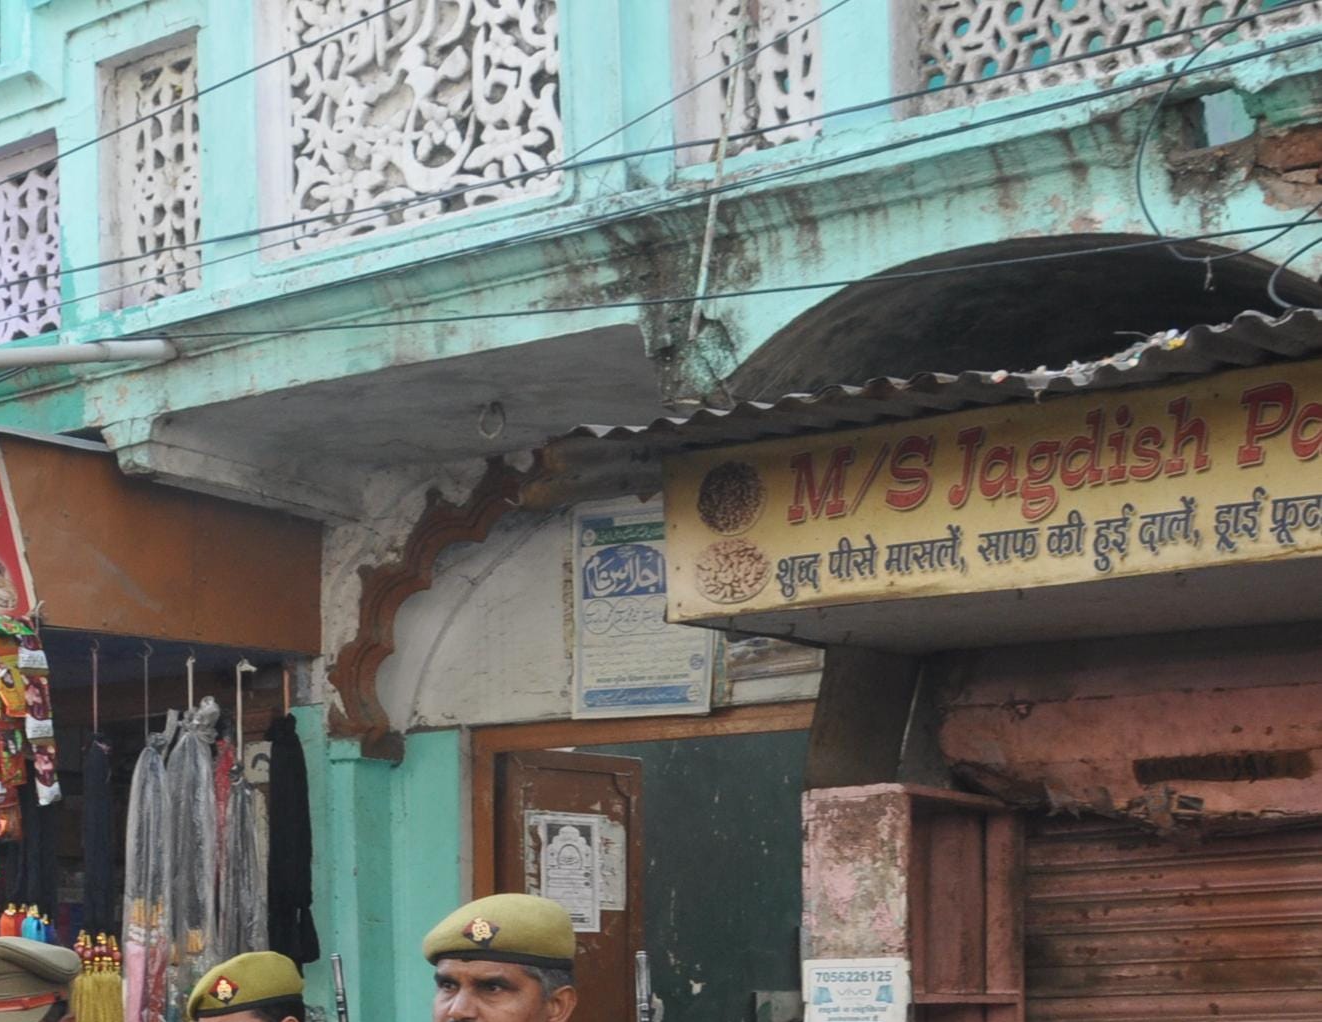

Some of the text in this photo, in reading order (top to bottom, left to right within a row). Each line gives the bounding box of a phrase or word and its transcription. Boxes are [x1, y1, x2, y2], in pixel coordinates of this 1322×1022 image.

[787, 434, 934, 523] M/S
[948, 396, 1211, 521] Jagdish
[978, 527, 1040, 563] साफ
[1047, 510, 1086, 555] की
[1093, 503, 1134, 572] हुई
